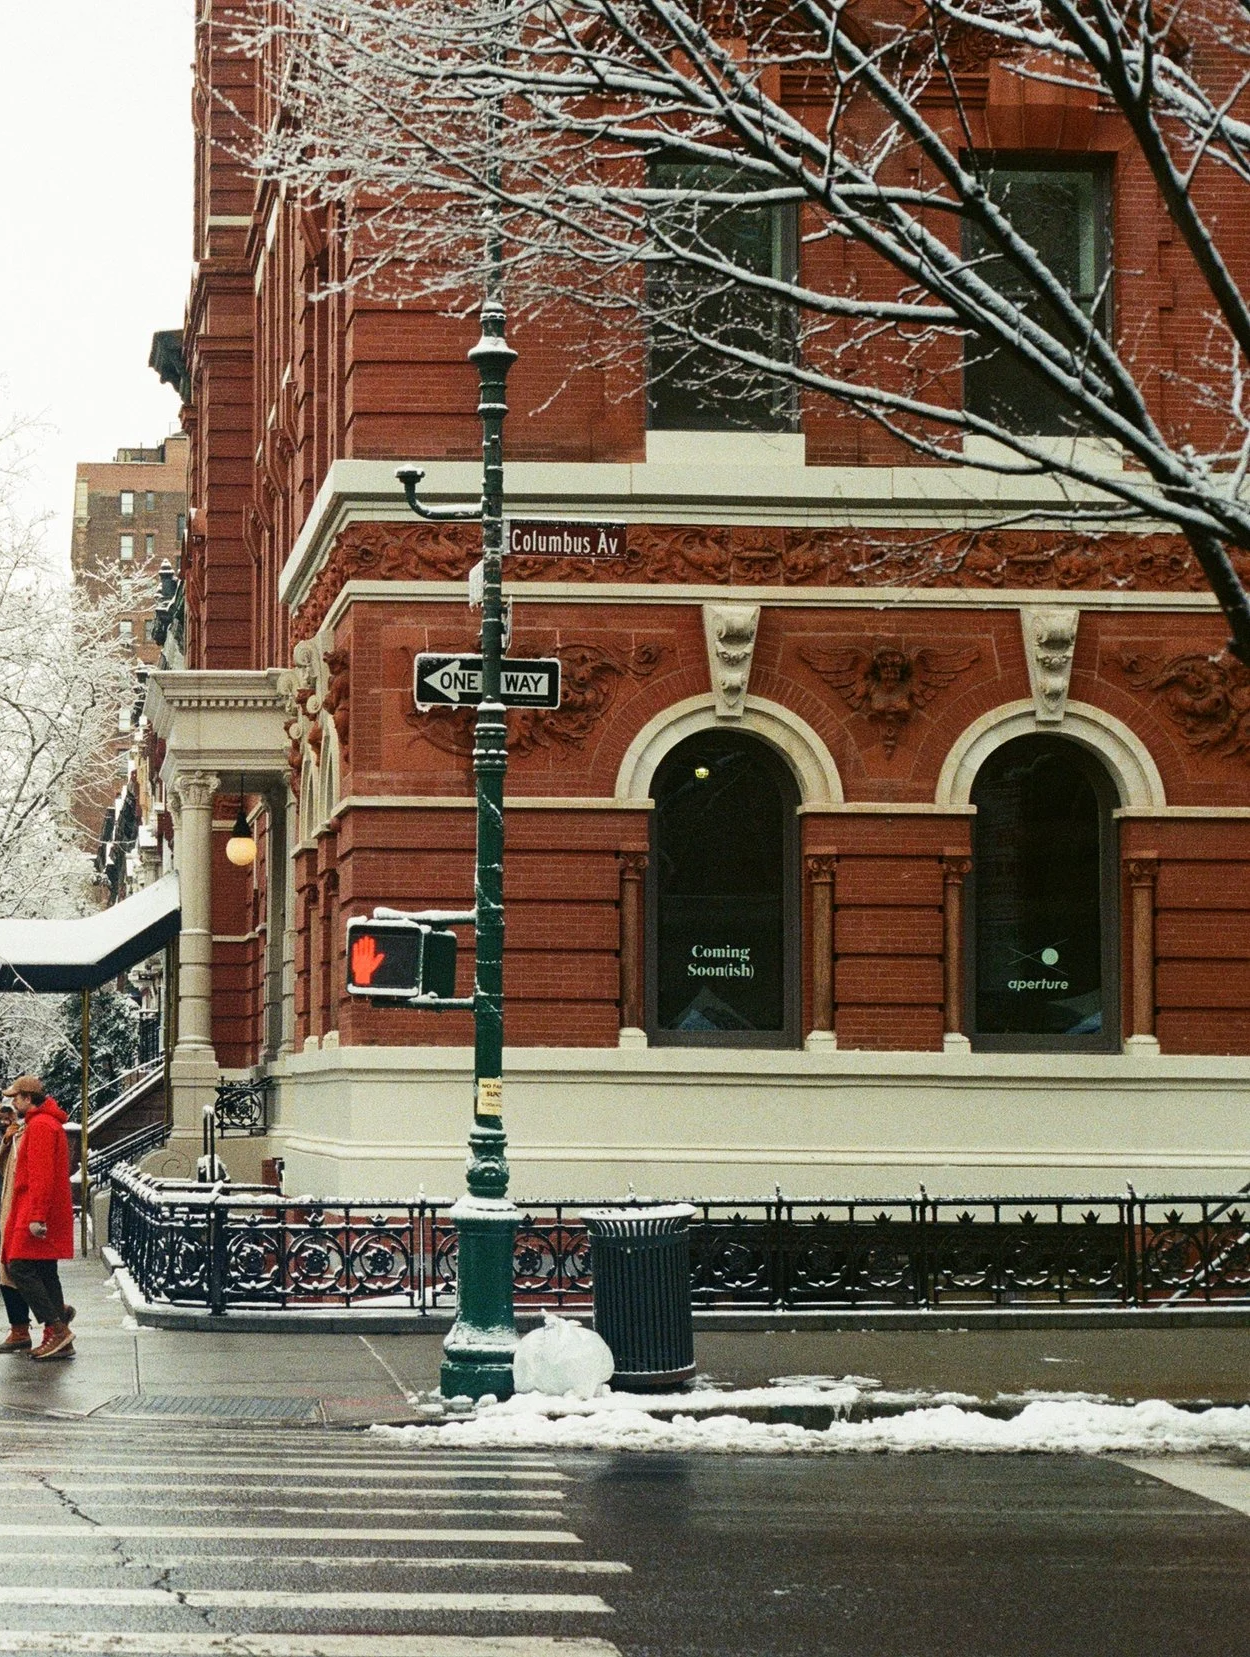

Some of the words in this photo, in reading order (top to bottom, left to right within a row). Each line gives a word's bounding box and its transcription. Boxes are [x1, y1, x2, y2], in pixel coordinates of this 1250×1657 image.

[511, 529, 591, 553] Columbus
[597, 531, 618, 554] Av
[440, 671, 478, 690] ONE
[504, 674, 543, 693] WAY
[691, 944, 751, 962] Coming
[687, 963, 755, 980] Soon(ish)
[1007, 978, 1069, 991] aperture
